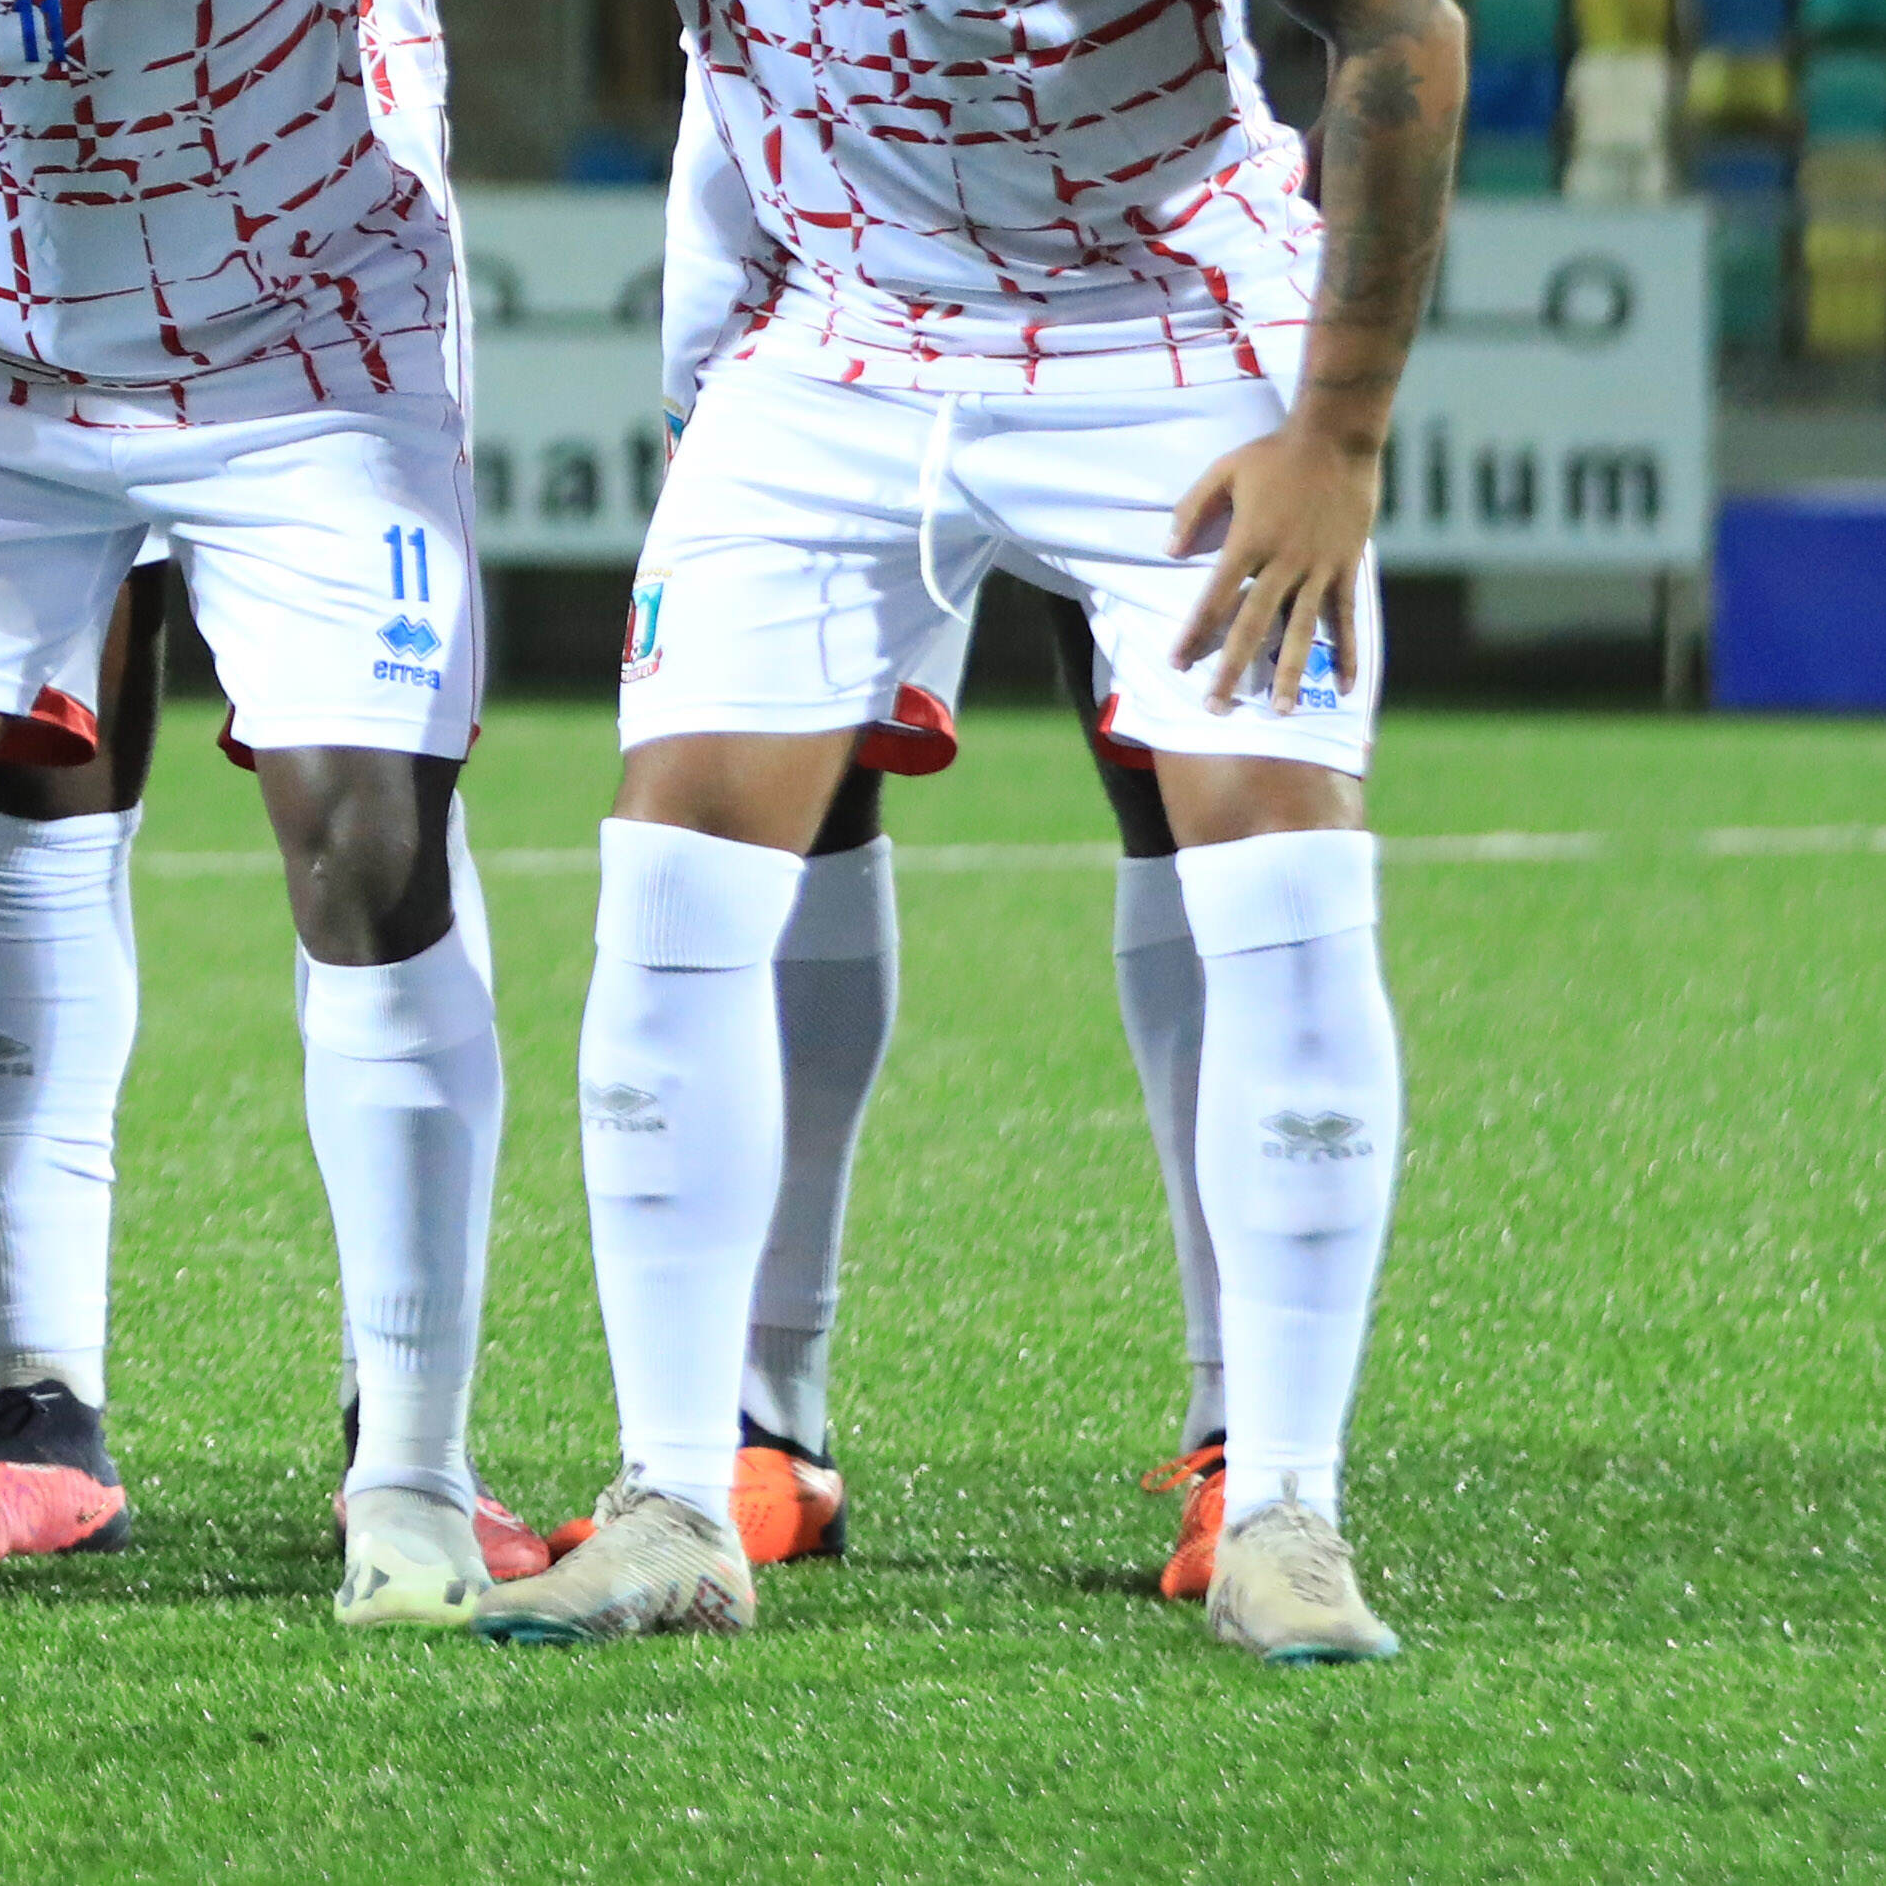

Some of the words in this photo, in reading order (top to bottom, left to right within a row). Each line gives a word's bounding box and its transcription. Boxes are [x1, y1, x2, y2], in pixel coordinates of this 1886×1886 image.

[383, 524, 429, 602] 11
[373, 659, 441, 691] errea
[1296, 687, 1337, 709] rea
